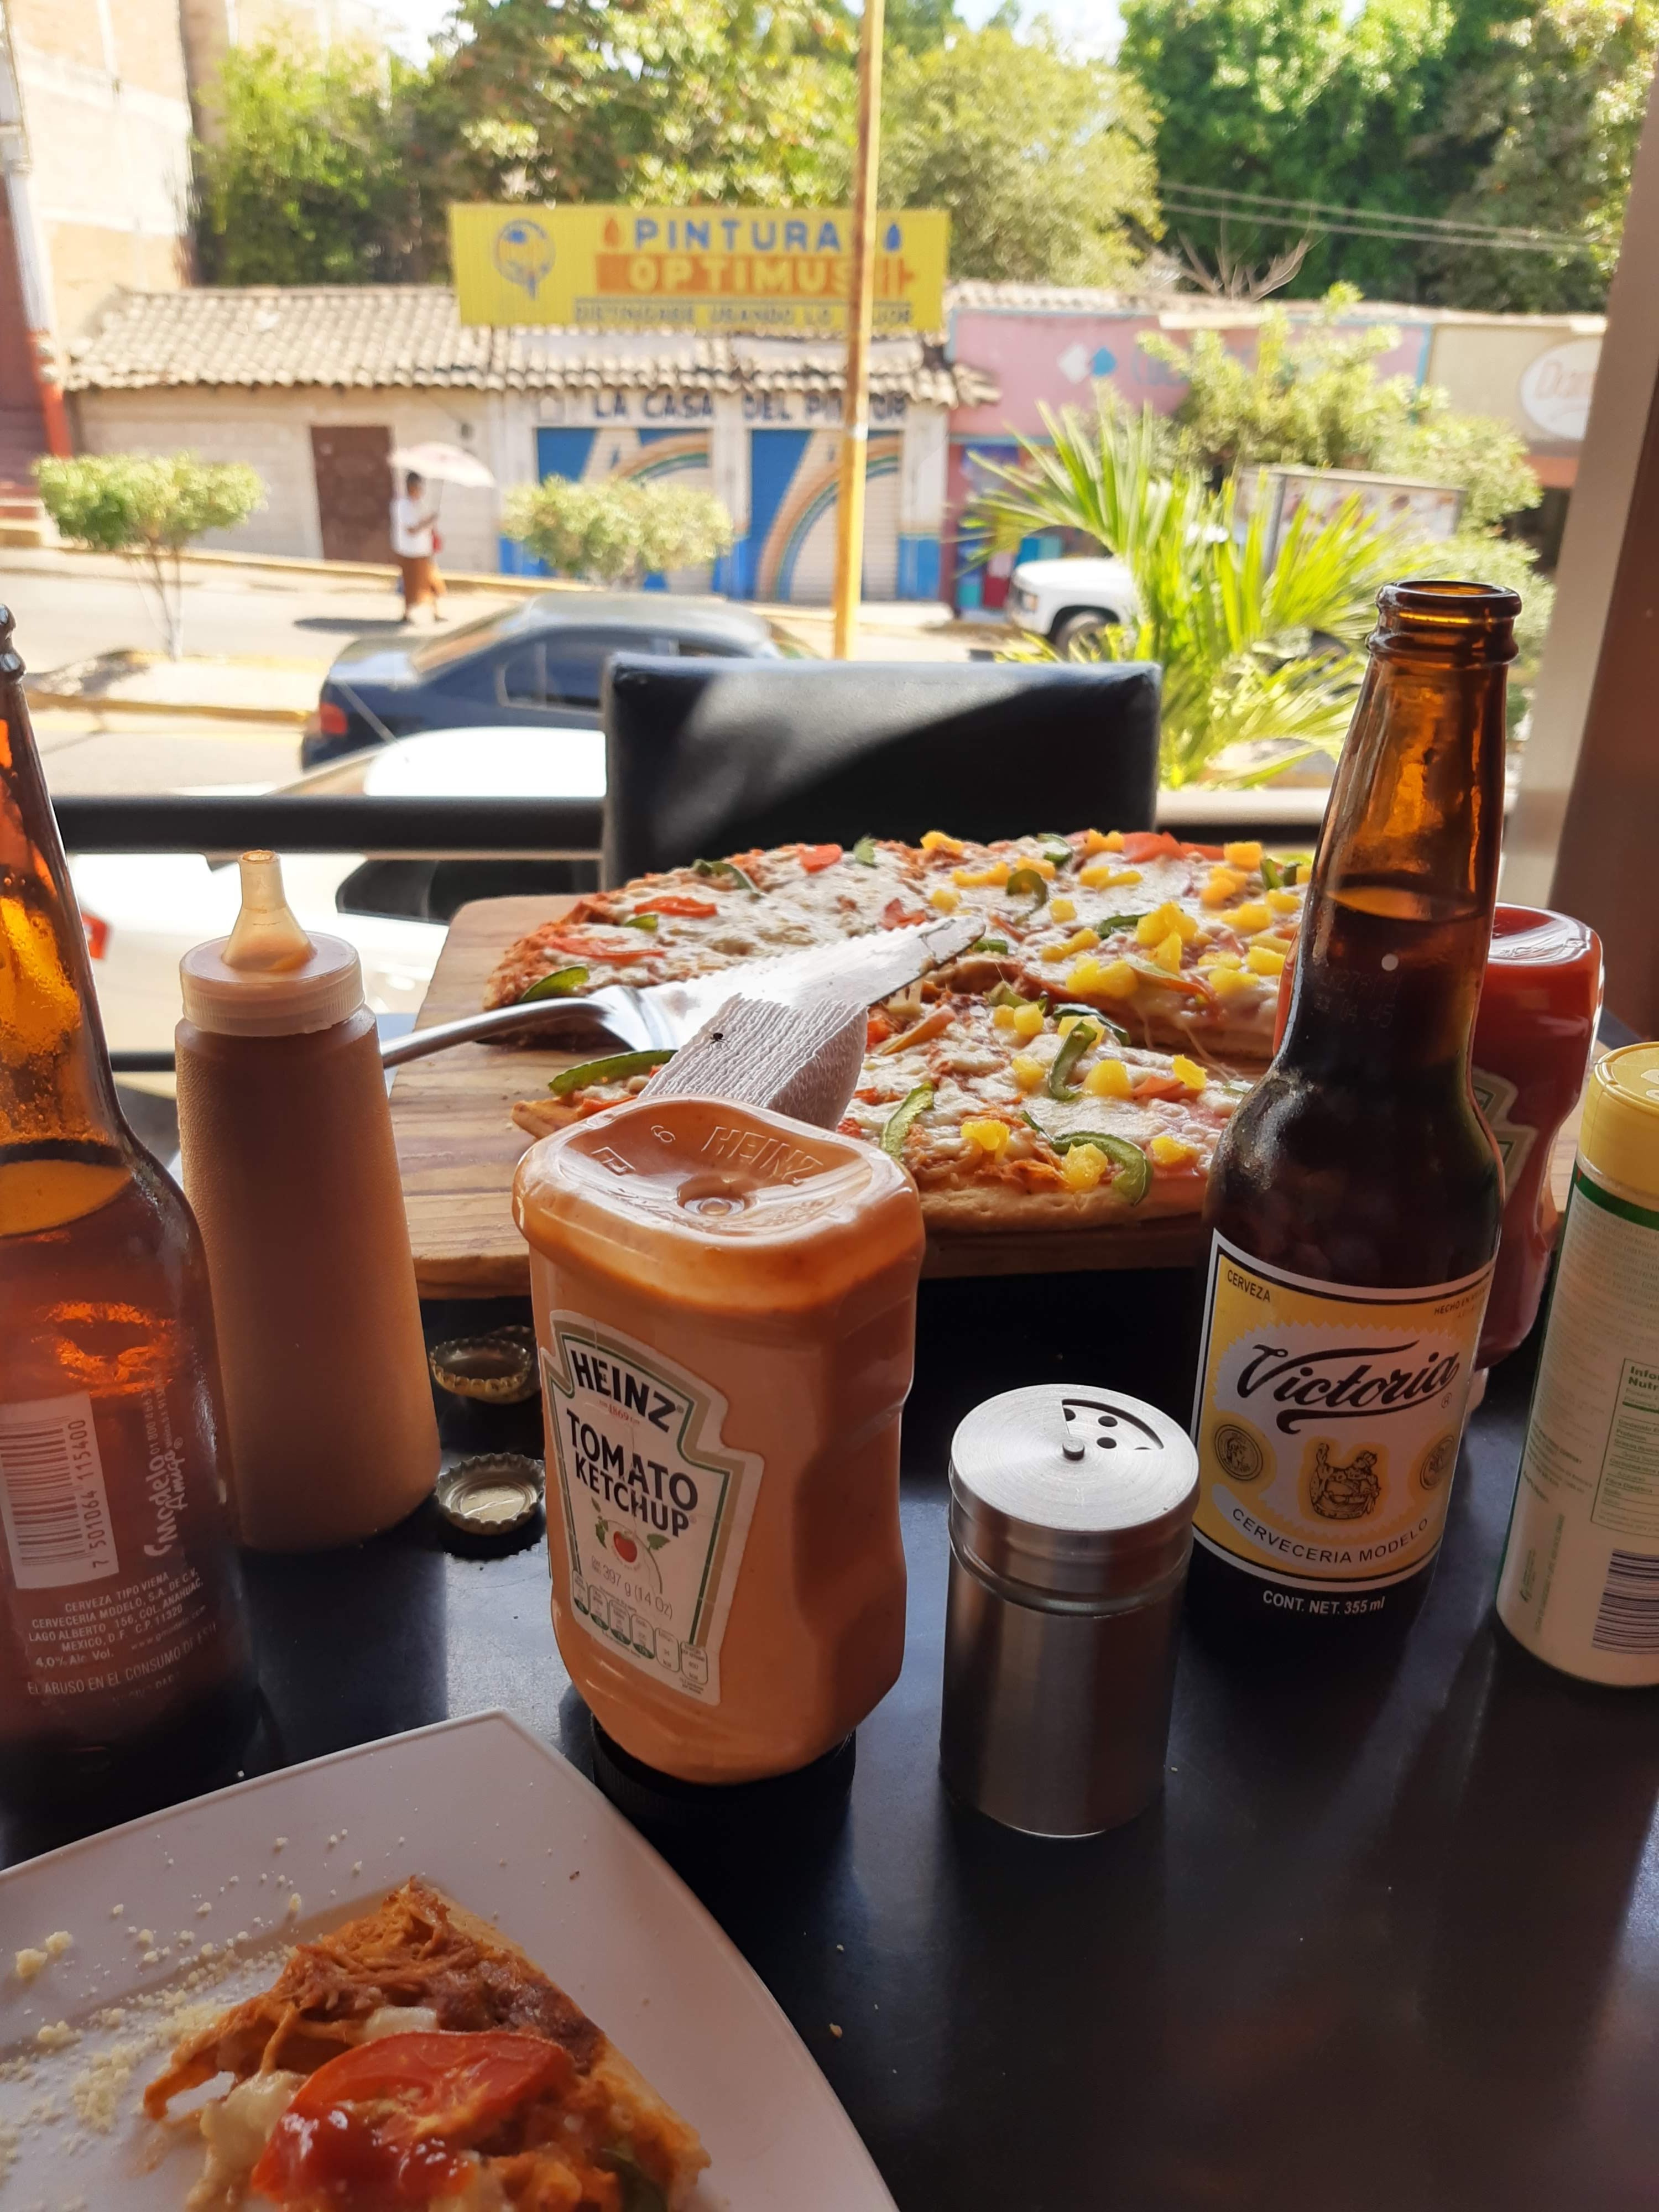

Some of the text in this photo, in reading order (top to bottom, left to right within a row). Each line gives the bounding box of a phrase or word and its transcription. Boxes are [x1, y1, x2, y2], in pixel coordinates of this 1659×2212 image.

[635, 218, 841, 252] PINTURA
[594, 390, 907, 420] LA CASA DEL PINOR
[701, 1125, 824, 1185] HEINZ
[1227, 1269, 1271, 1303] CERVEZA
[1434, 1300, 1460, 1315] HECHO
[570, 1349, 677, 1433] HEINZ
[1237, 1340, 1460, 1434] Victoria
[146, 1421, 159, 1441] 800
[567, 1408, 698, 1512] TOMATO
[68, 1419, 109, 1568] 7 501064 115400
[576, 1451, 690, 1538] KETCHUP
[1232, 1507, 1428, 1564] CERVECERIA MODELO
[32, 1613, 96, 1629] CERVECERIA
[169, 1580, 180, 1592] DE
[65, 1572, 169, 1613] CERVEZA TIPO VIENA
[603, 1564, 622, 1587] 397
[624, 1582, 631, 1597] g
[634, 1584, 651, 1606] (14
[1262, 1589, 1385, 1615] CONT. NET. 355 ml
[29, 1631, 55, 1642] LAGO
[59, 1624, 106, 1640] ALBERTO
[156, 1604, 182, 1625] 11320
[28, 1681, 39, 1695] EL
[44, 1679, 85, 1695] ABUSO
[88, 1675, 105, 1691] EN
[108, 1671, 121, 1687] EL
[125, 1645, 182, 1682] CONSUMO
